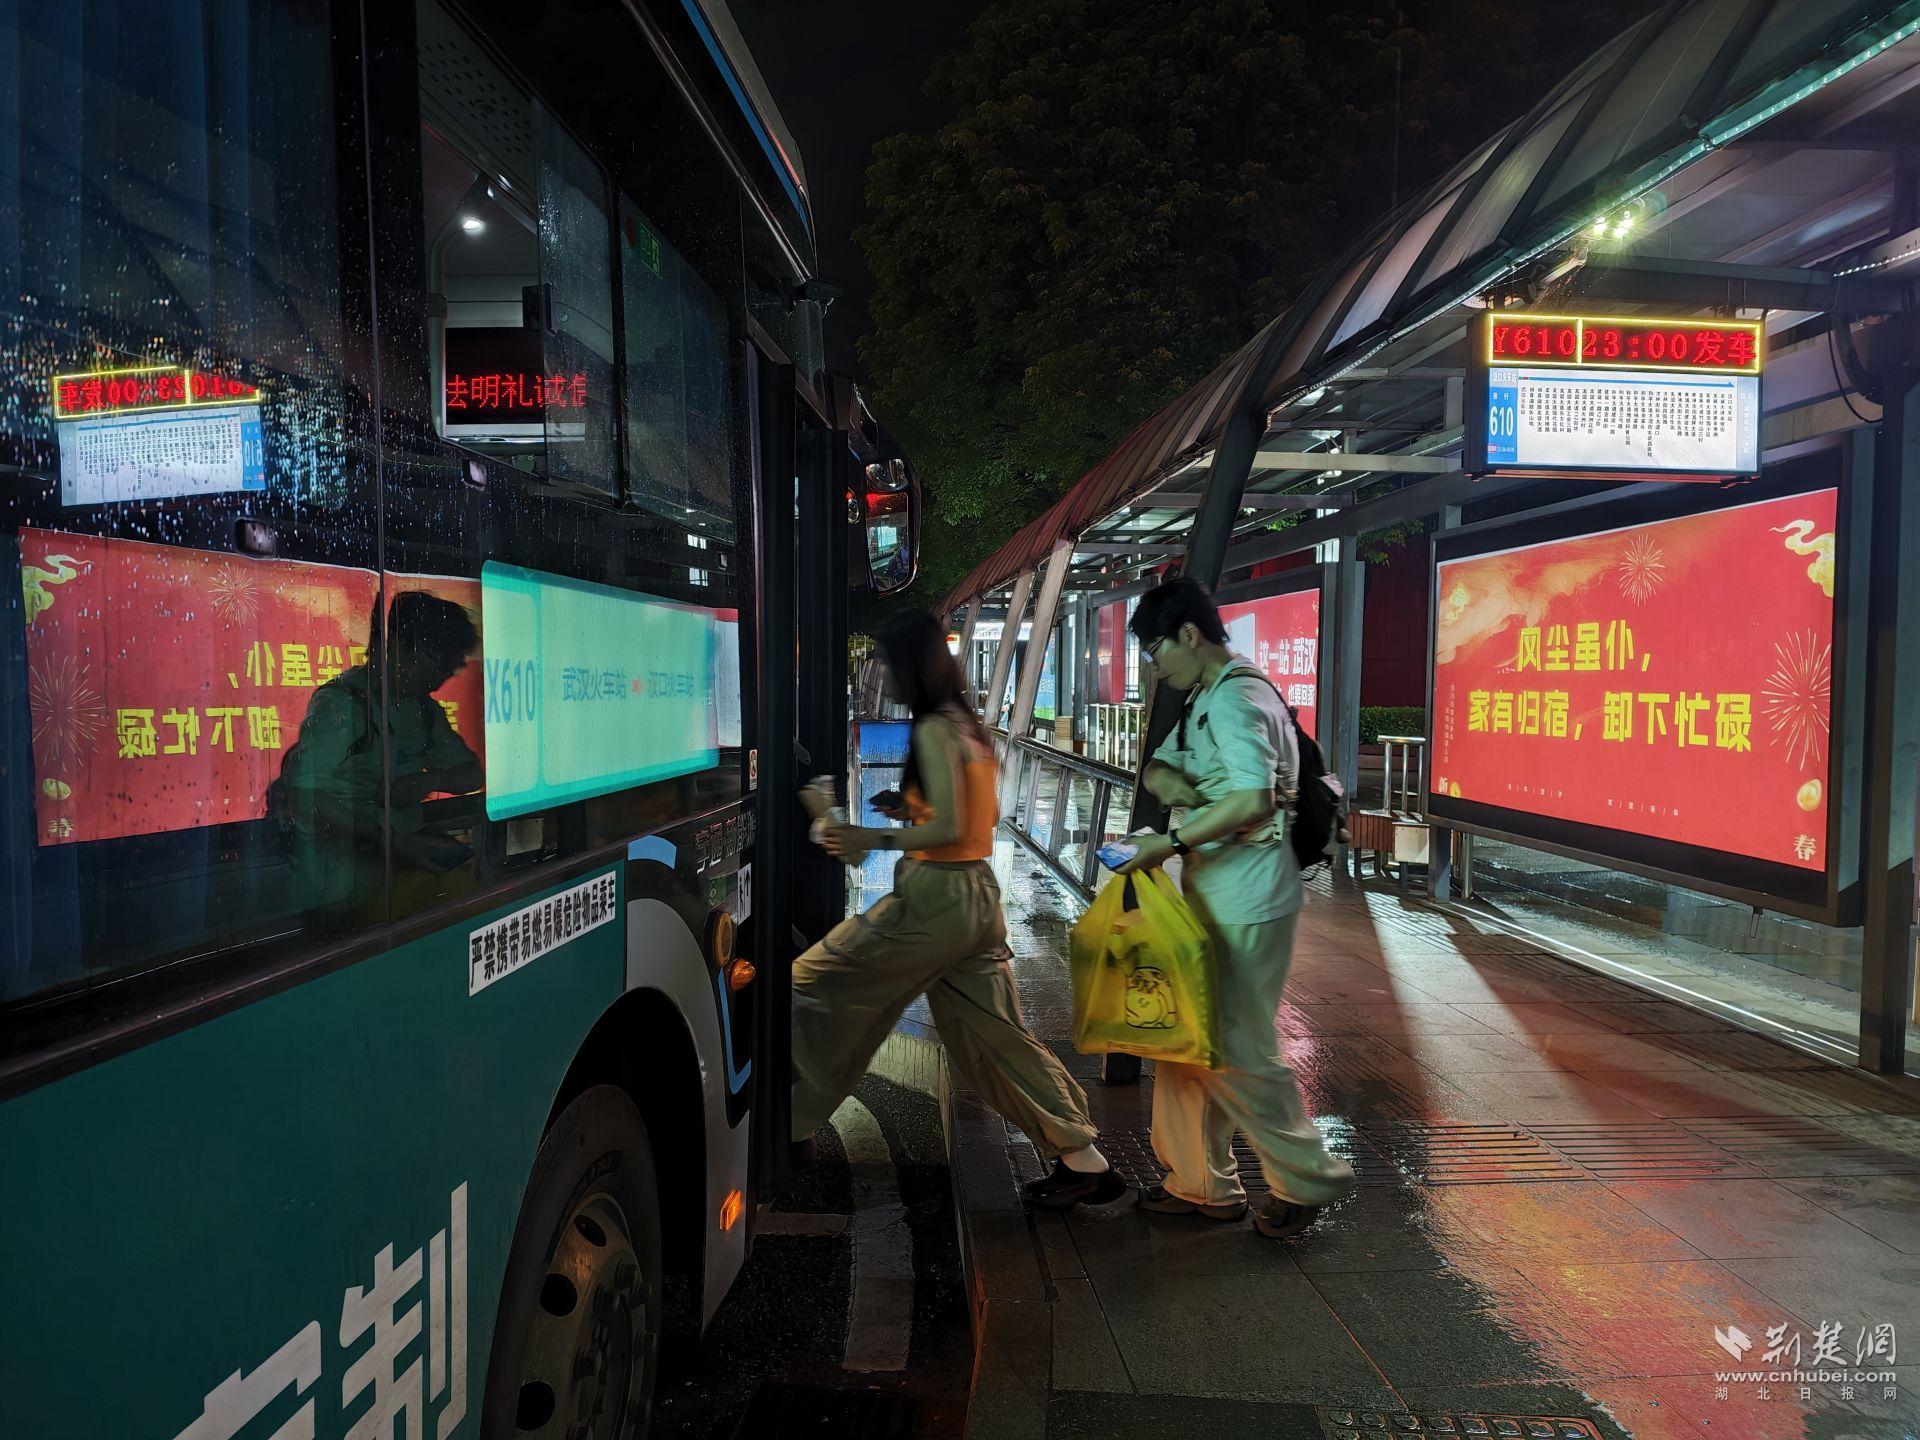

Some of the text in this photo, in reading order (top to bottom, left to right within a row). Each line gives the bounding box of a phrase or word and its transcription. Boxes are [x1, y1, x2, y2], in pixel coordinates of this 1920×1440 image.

[1582, 329, 1757, 365] 23:00发车
[1490, 405, 1514, 436] 610
[485, 658, 536, 723] X610
[562, 667, 694, 701] 武汉火车站 汉口火车站
[1793, 834, 1817, 861] 春
[470, 875, 615, 988] 严禁携带易燃易爆危险物品乘车
